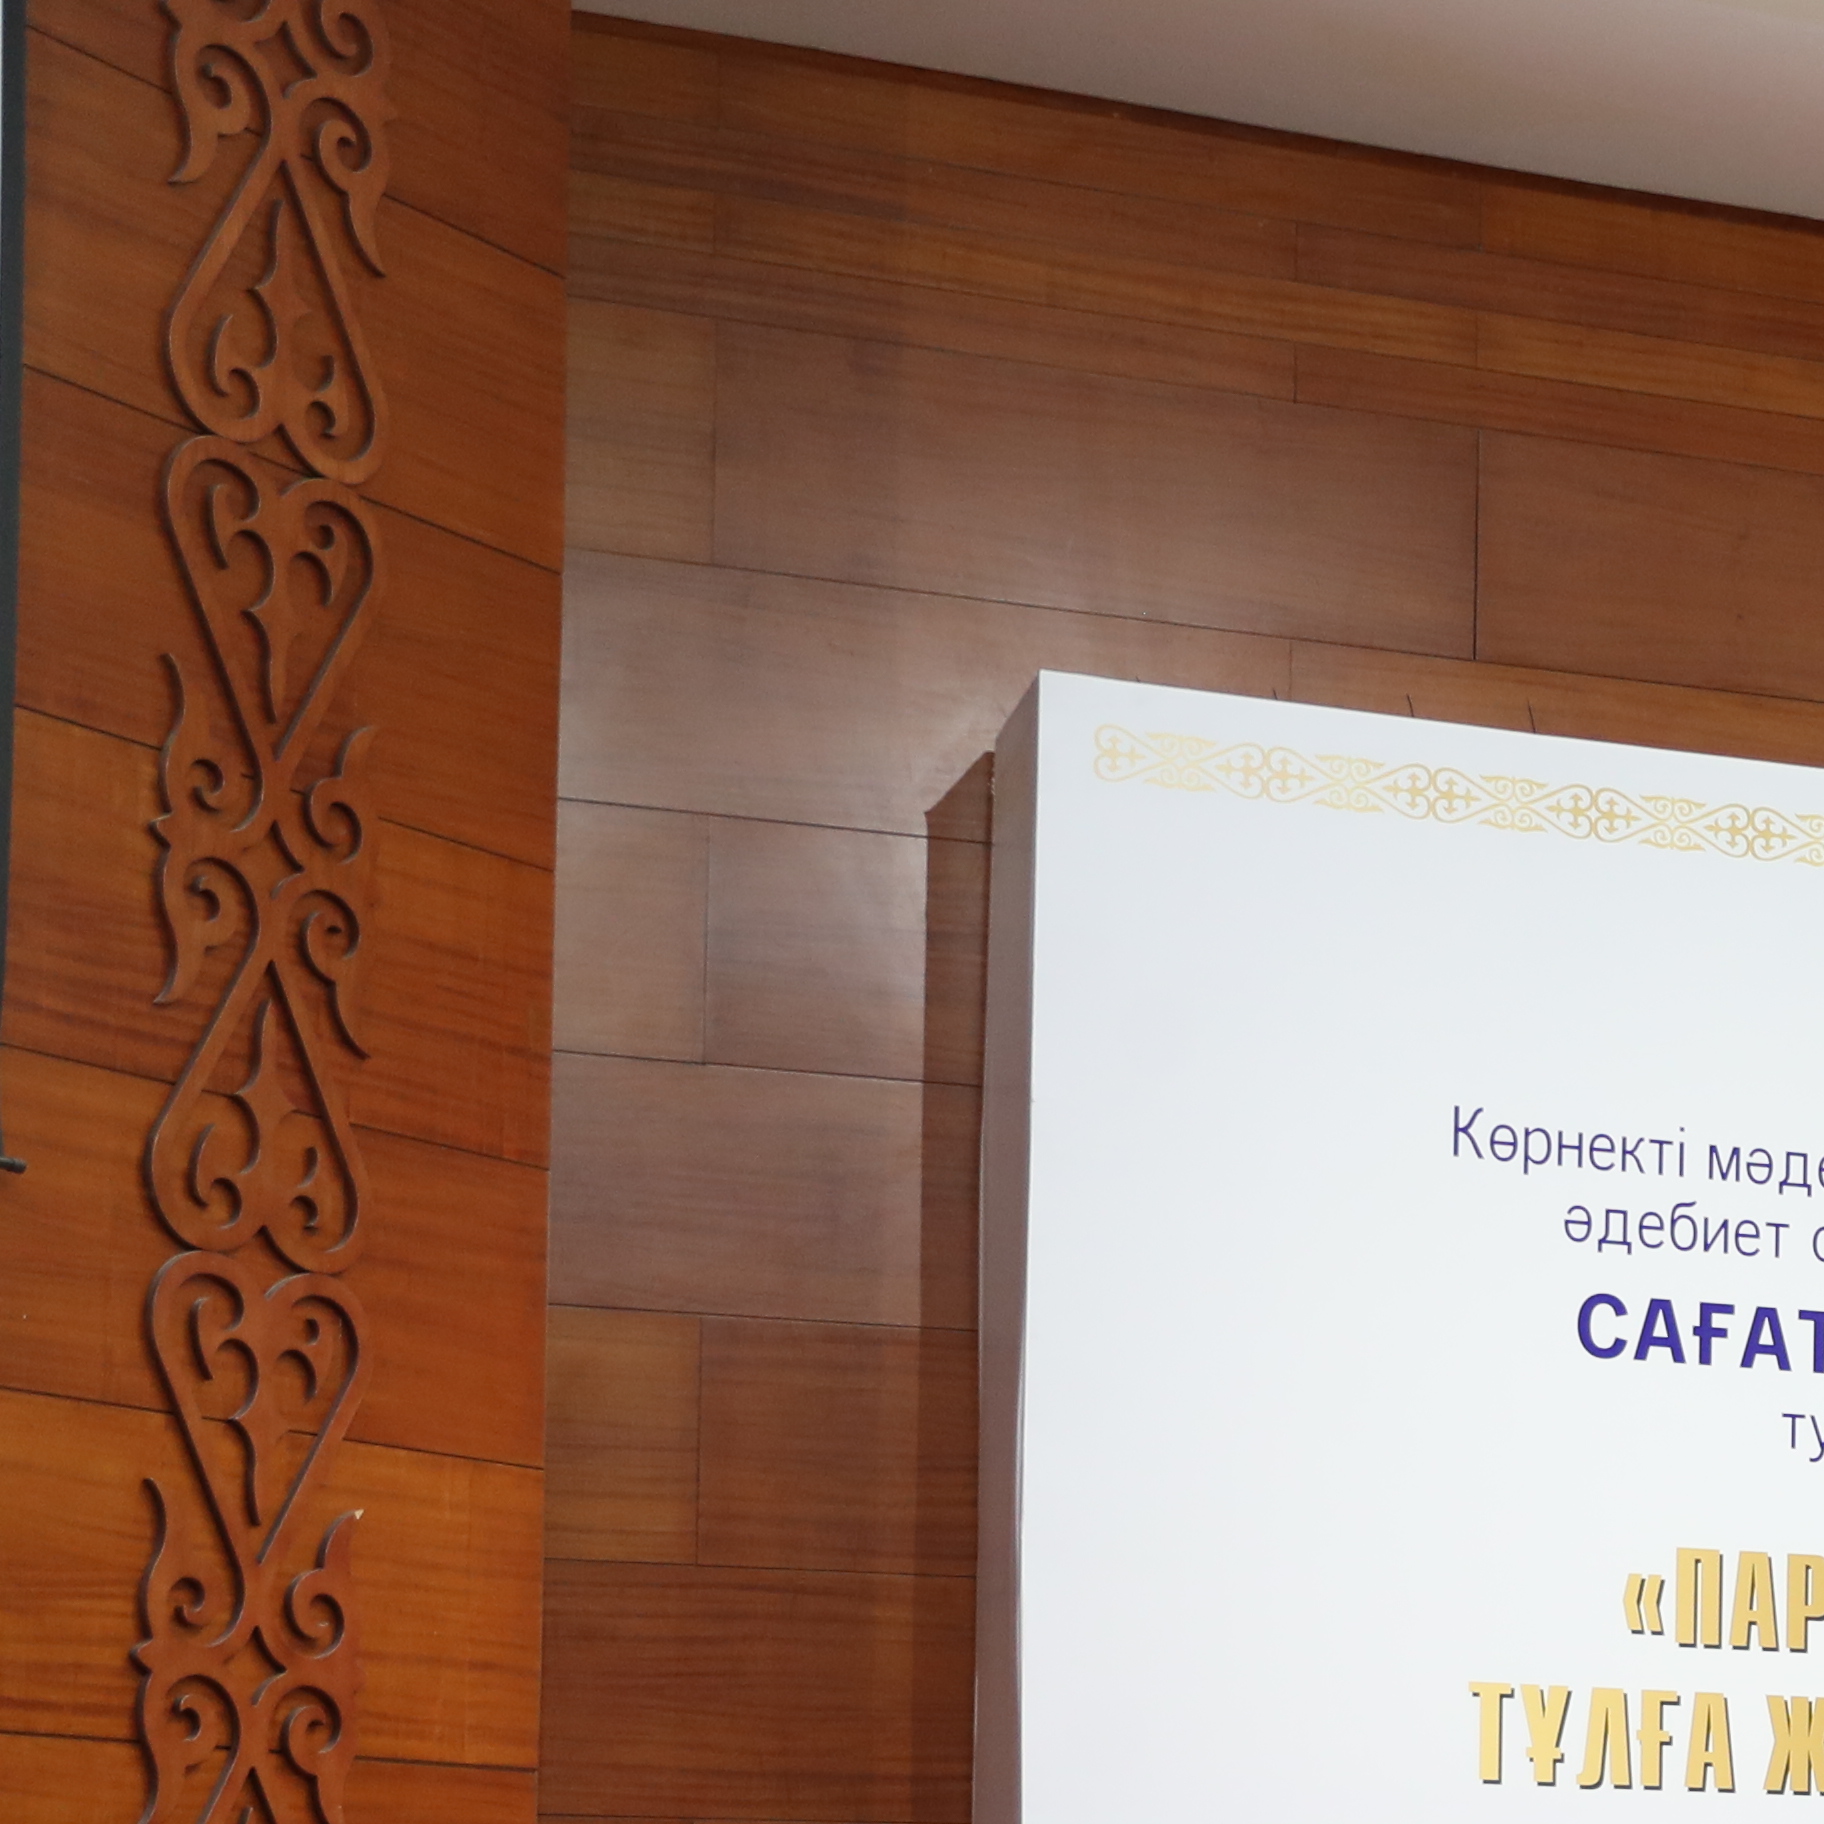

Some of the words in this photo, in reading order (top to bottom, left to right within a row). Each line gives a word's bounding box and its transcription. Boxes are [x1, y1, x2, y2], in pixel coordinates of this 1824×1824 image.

[1453, 1106, 1684, 1177] Көрнекті
[1564, 1201, 1790, 1258] әдебиет
[1468, 1681, 1737, 1793] ТҰЛҒА
